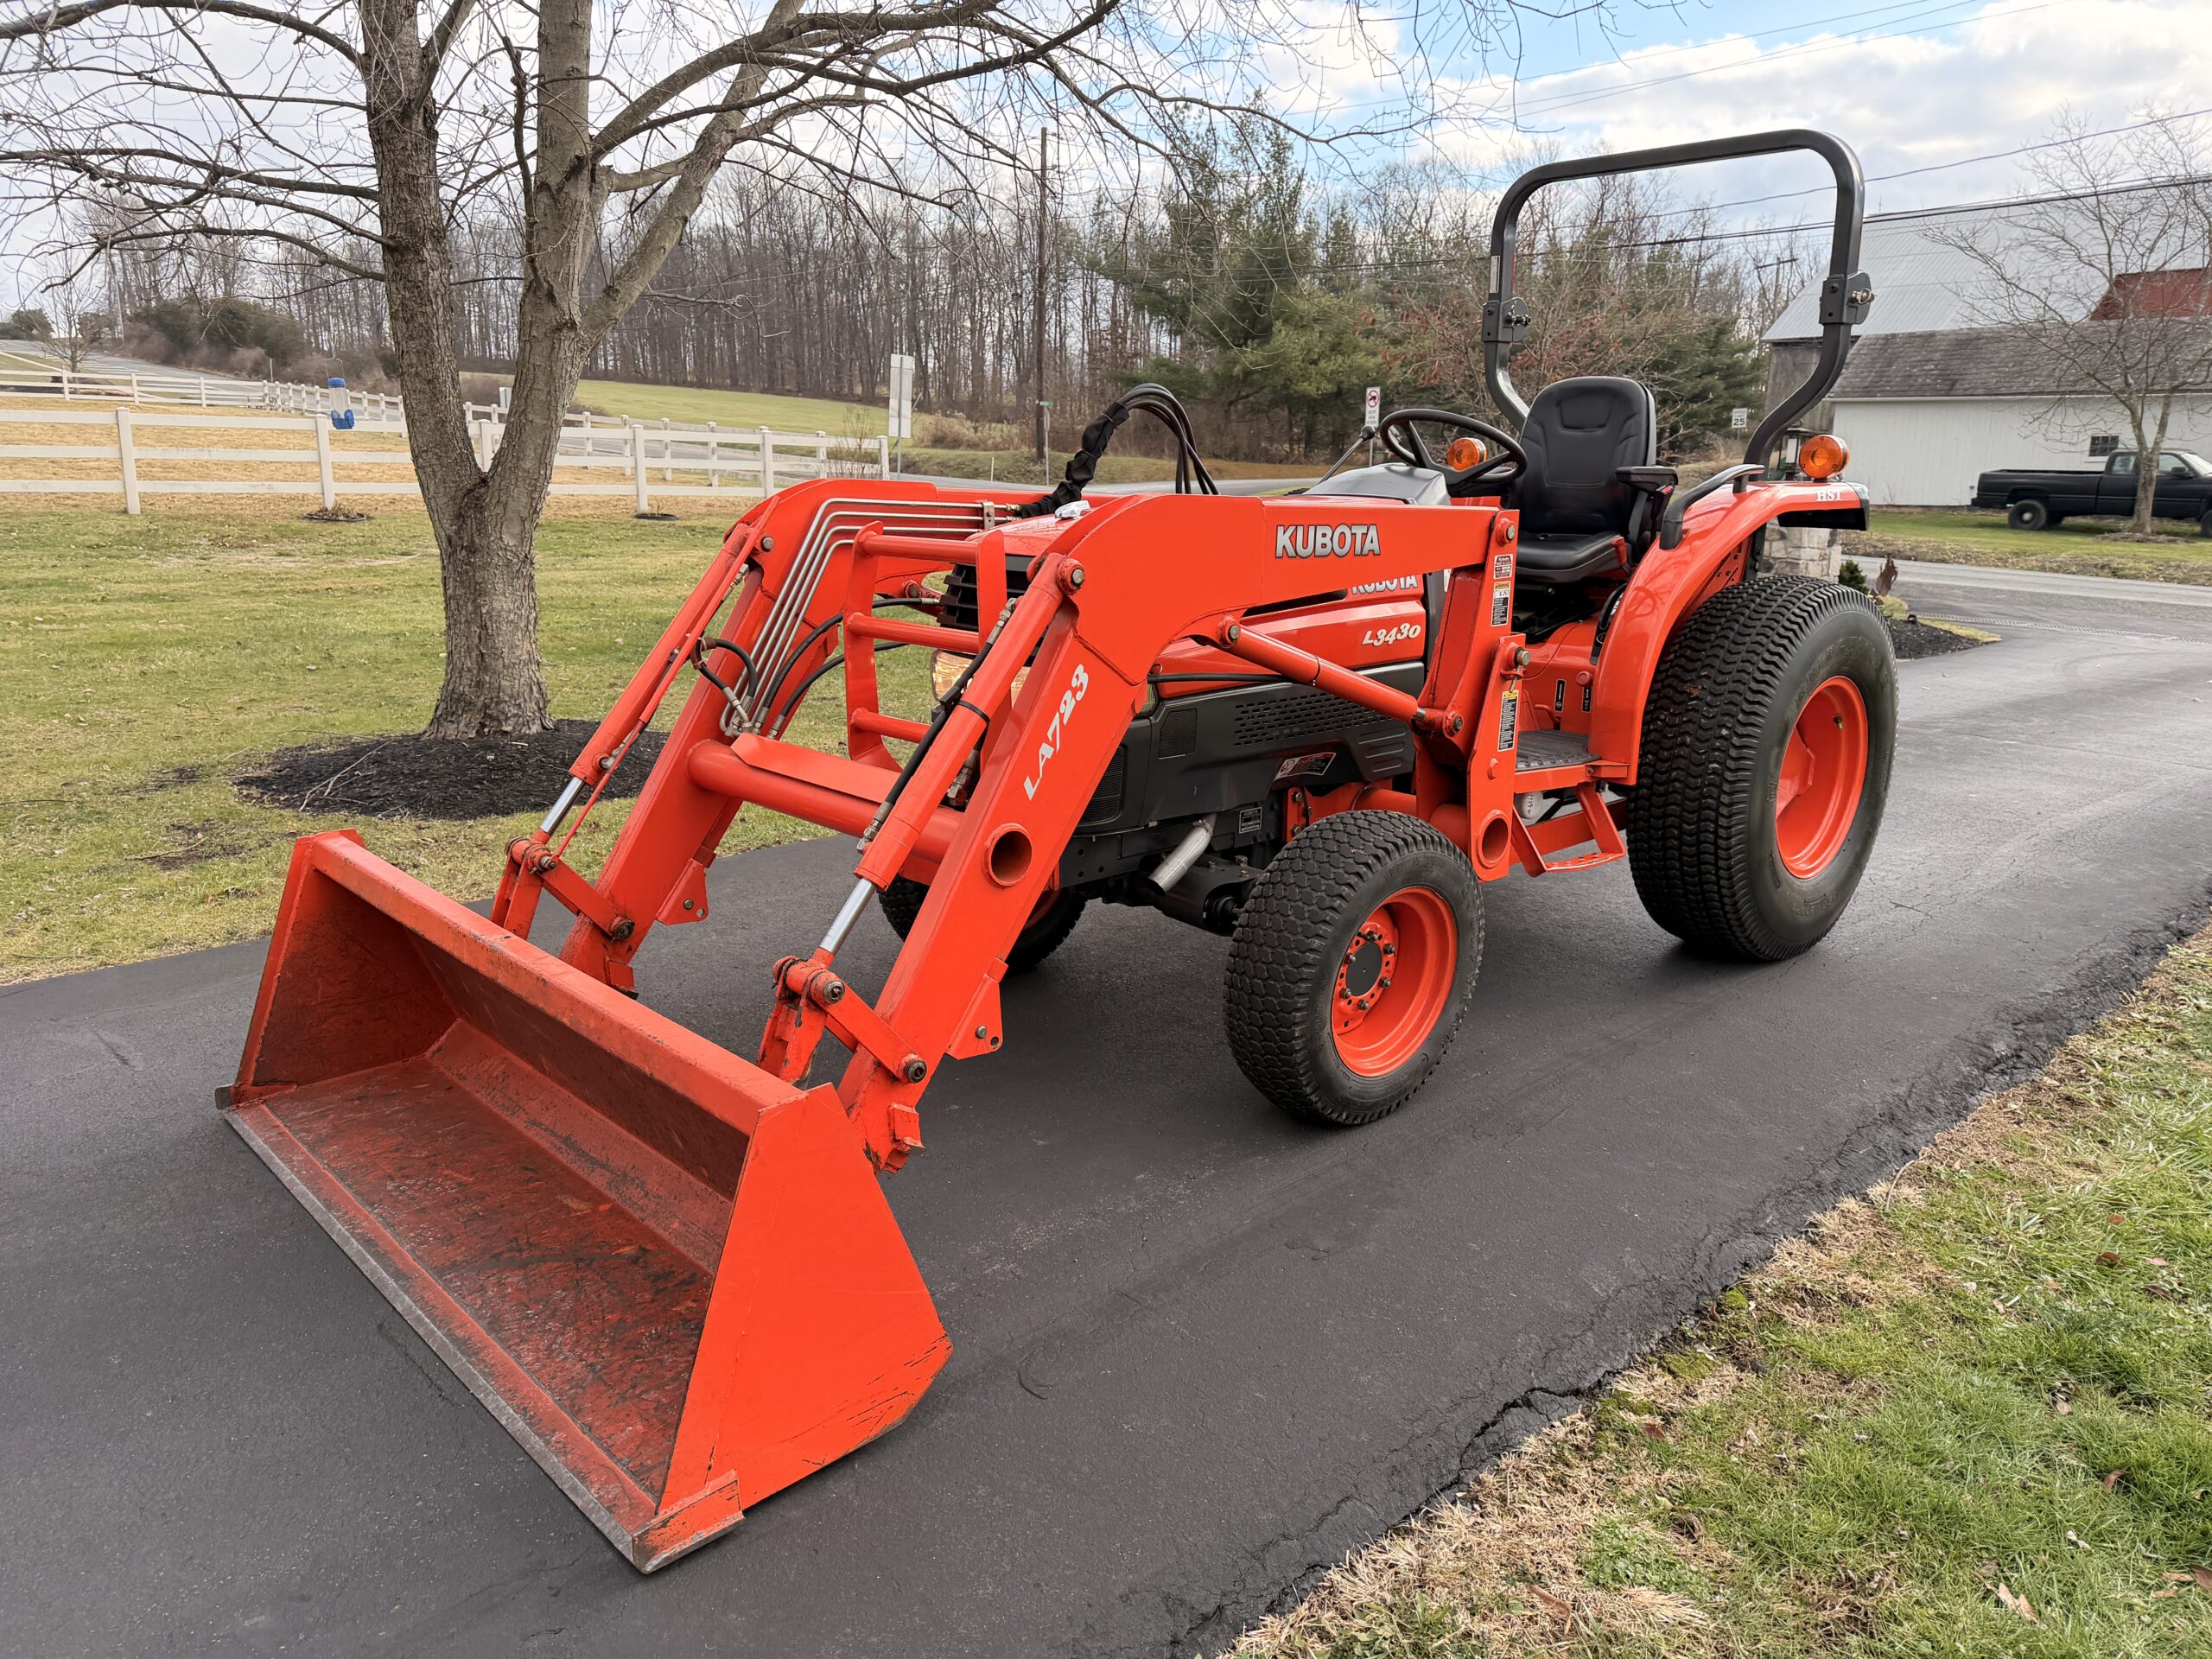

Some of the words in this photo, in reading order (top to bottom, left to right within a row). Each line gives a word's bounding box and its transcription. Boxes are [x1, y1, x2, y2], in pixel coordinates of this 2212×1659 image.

[1816, 489, 1842, 501] HST
[1275, 524, 1381, 558] KUBOTA
[1362, 622, 1421, 646] L3430
[1023, 664, 1089, 801] LA723
